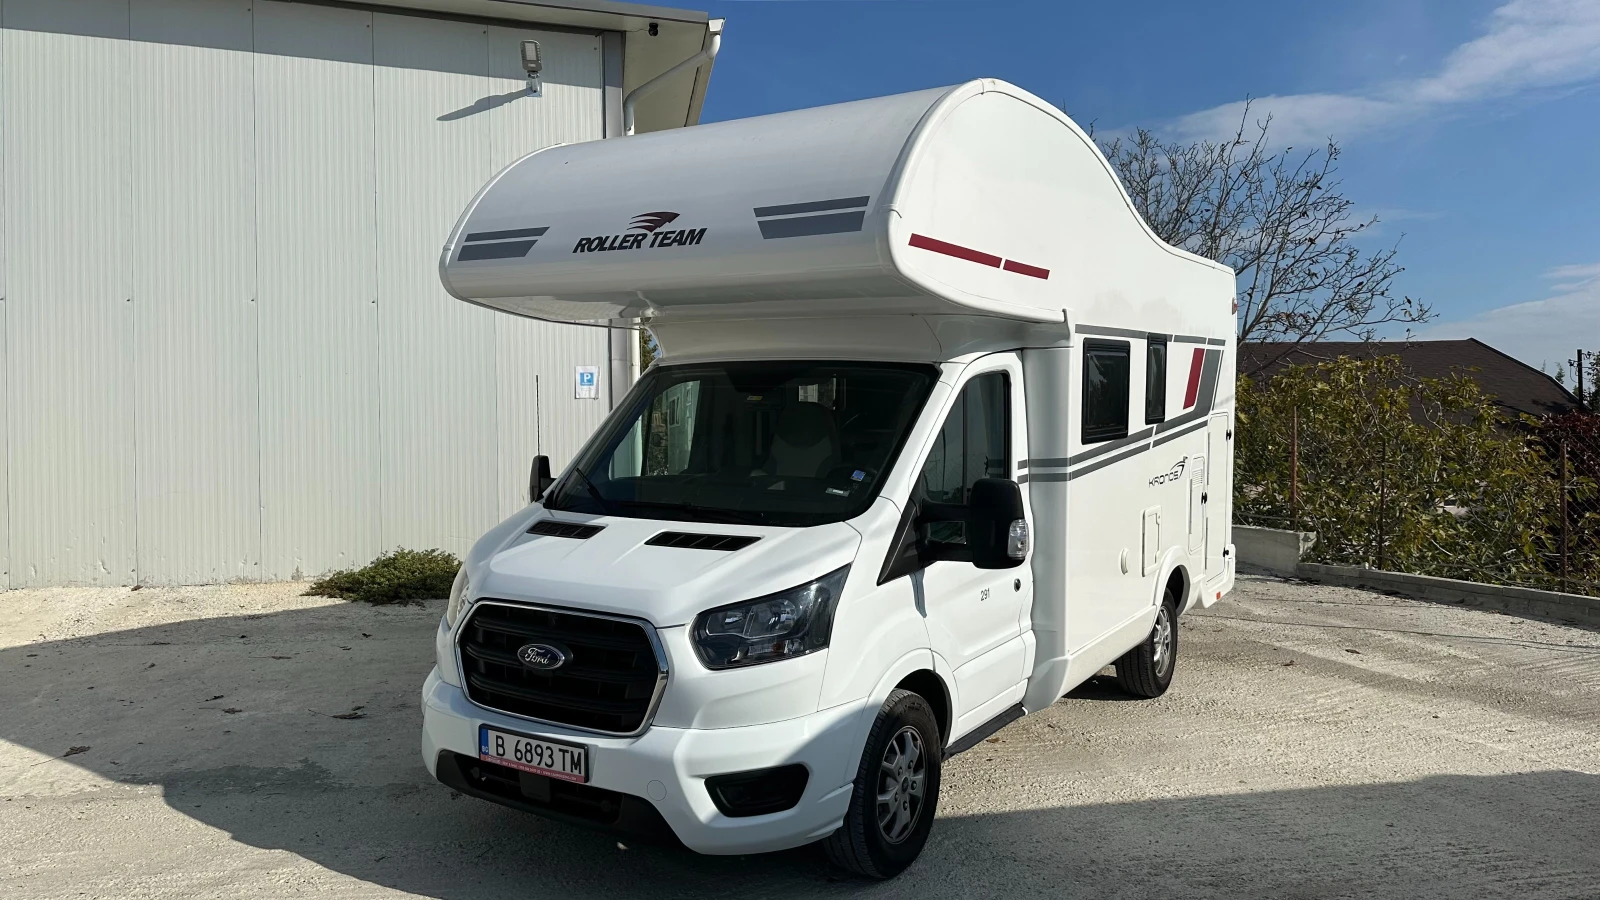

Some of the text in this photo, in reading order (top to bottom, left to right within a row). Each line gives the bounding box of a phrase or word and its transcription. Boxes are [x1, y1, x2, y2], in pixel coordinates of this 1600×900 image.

[572, 227, 708, 253] ROLLER TEAM
[583, 373, 591, 383] P
[1148, 470, 1179, 488] KRONOS
[980, 588, 990, 601] 291
[524, 647, 551, 665] Ford
[481, 745, 489, 754] BG
[495, 734, 506, 757] B
[514, 739, 555, 769] 6893
[558, 748, 582, 775] TM
